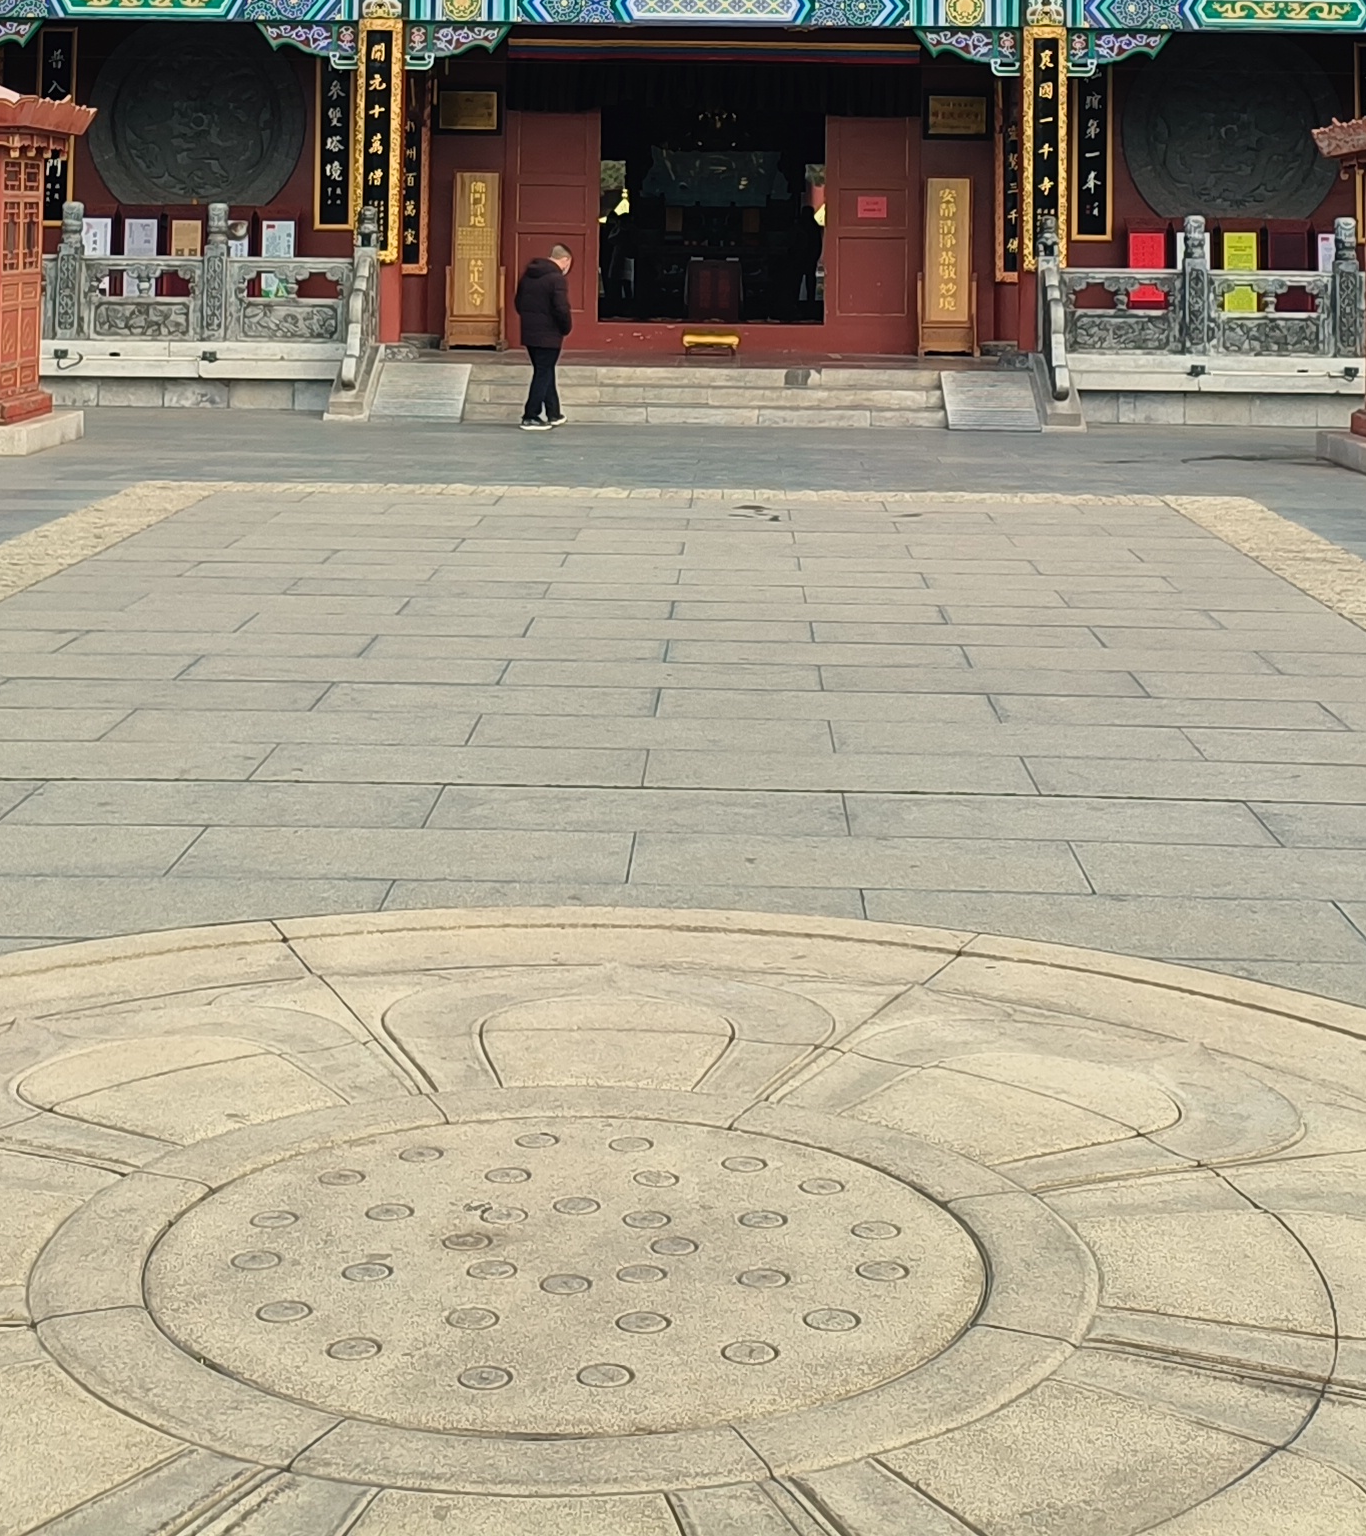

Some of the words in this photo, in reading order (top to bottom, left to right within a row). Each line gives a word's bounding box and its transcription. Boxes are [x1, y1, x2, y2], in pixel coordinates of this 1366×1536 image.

[47, 48, 67, 94] 普入
[367, 42, 387, 187] 開元十萬僧
